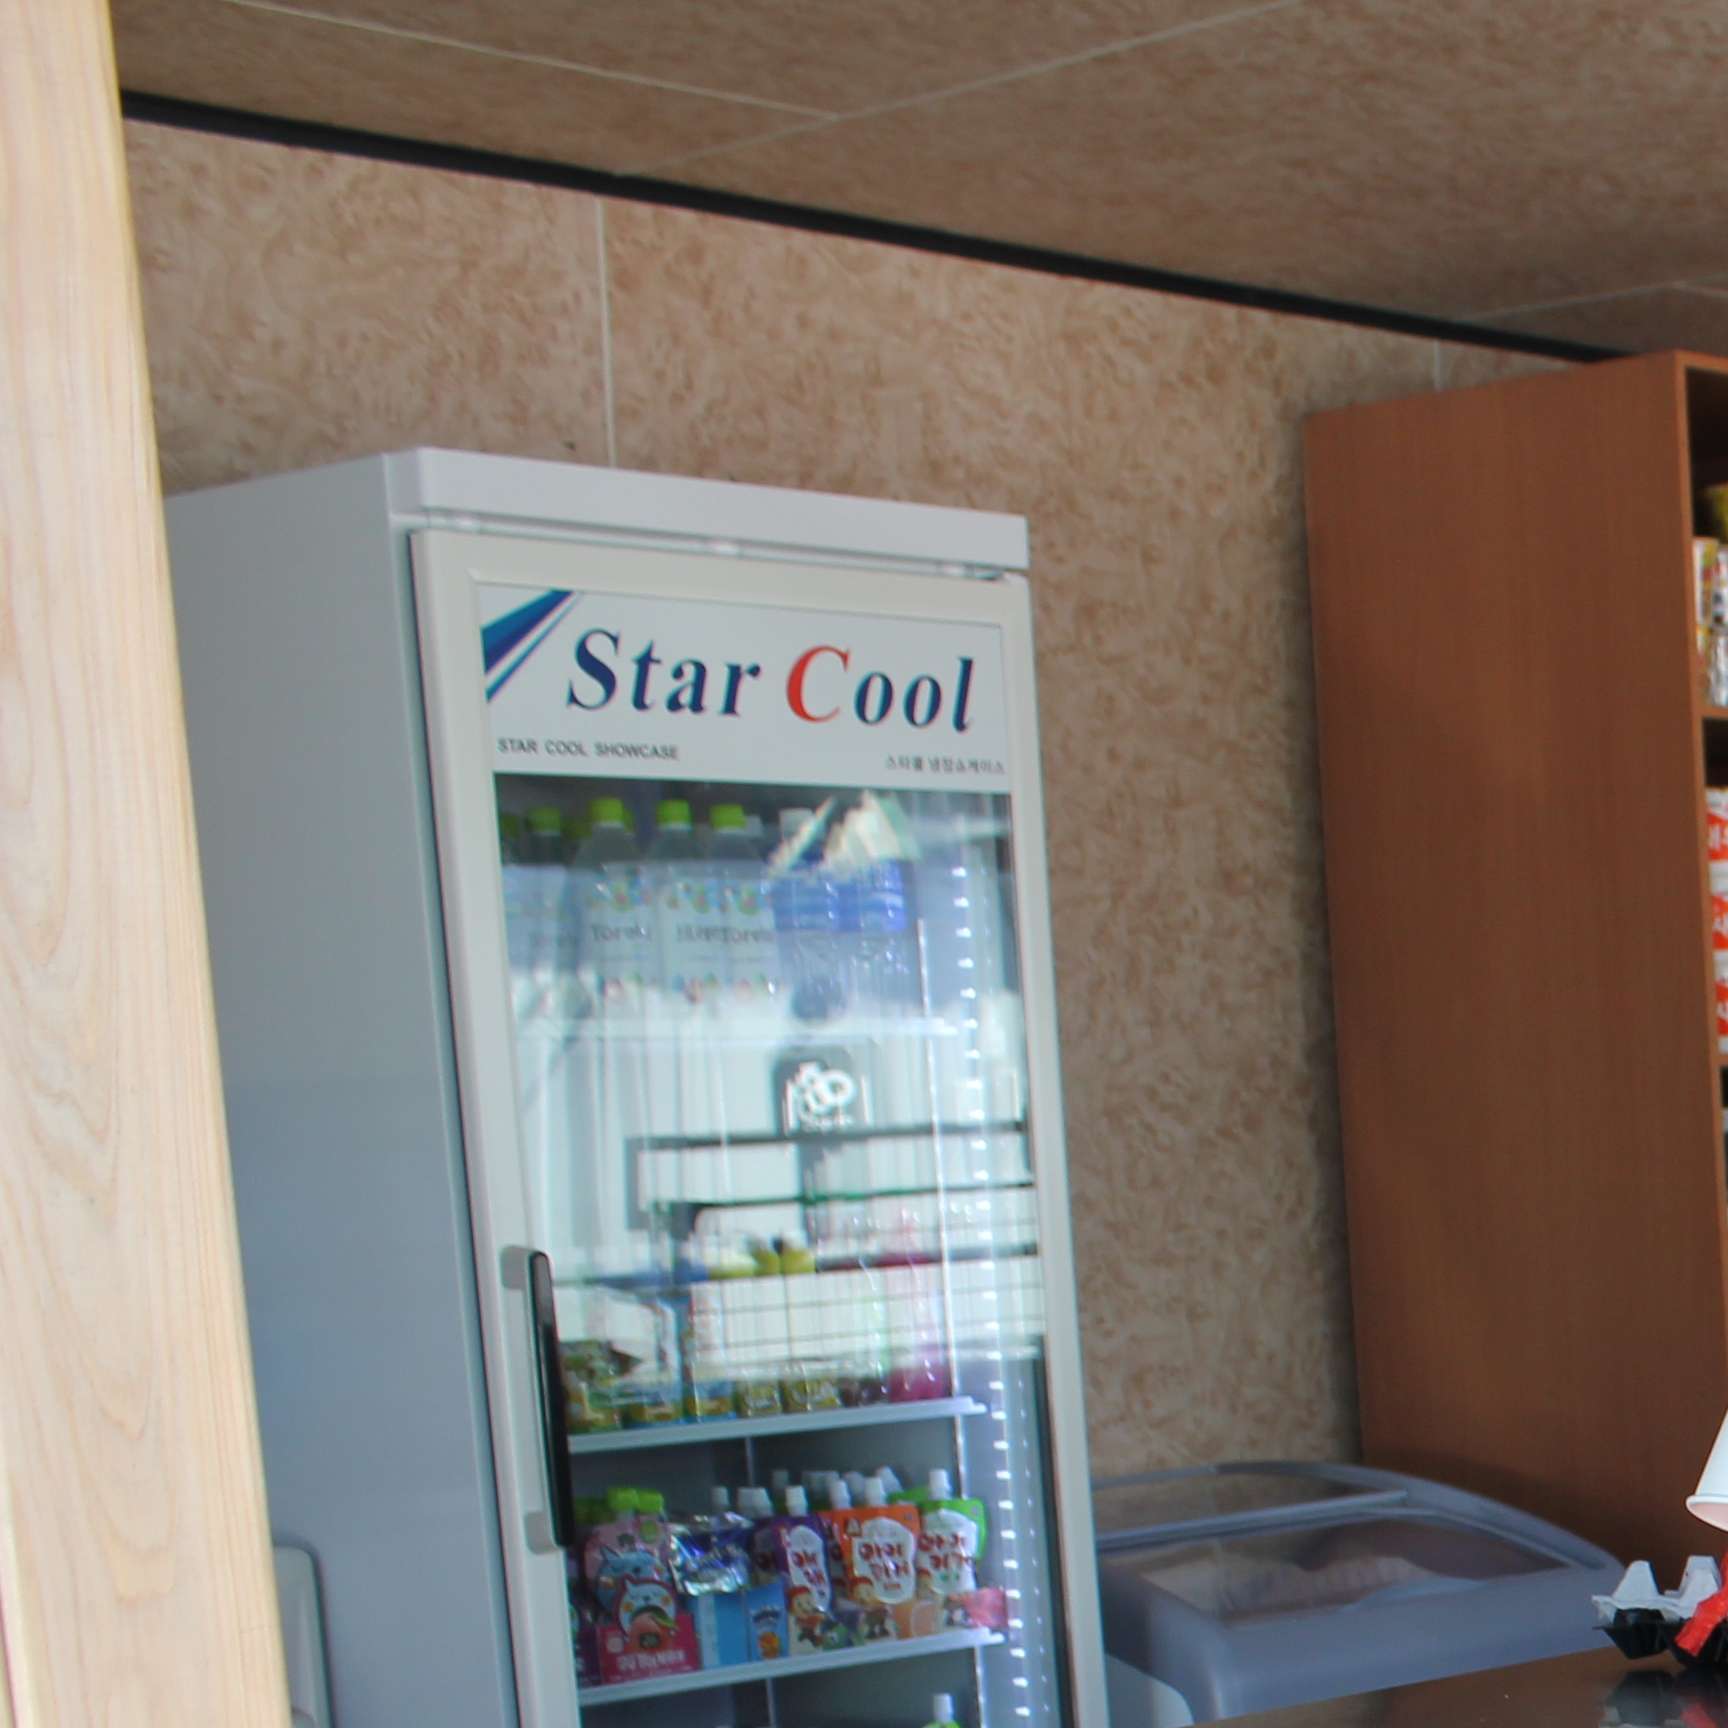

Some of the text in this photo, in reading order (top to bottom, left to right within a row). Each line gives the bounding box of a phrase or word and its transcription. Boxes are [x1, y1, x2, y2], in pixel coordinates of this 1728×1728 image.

[566, 627, 976, 734] Star Cool
[497, 737, 680, 761] STAR COOL SHOWCASE
